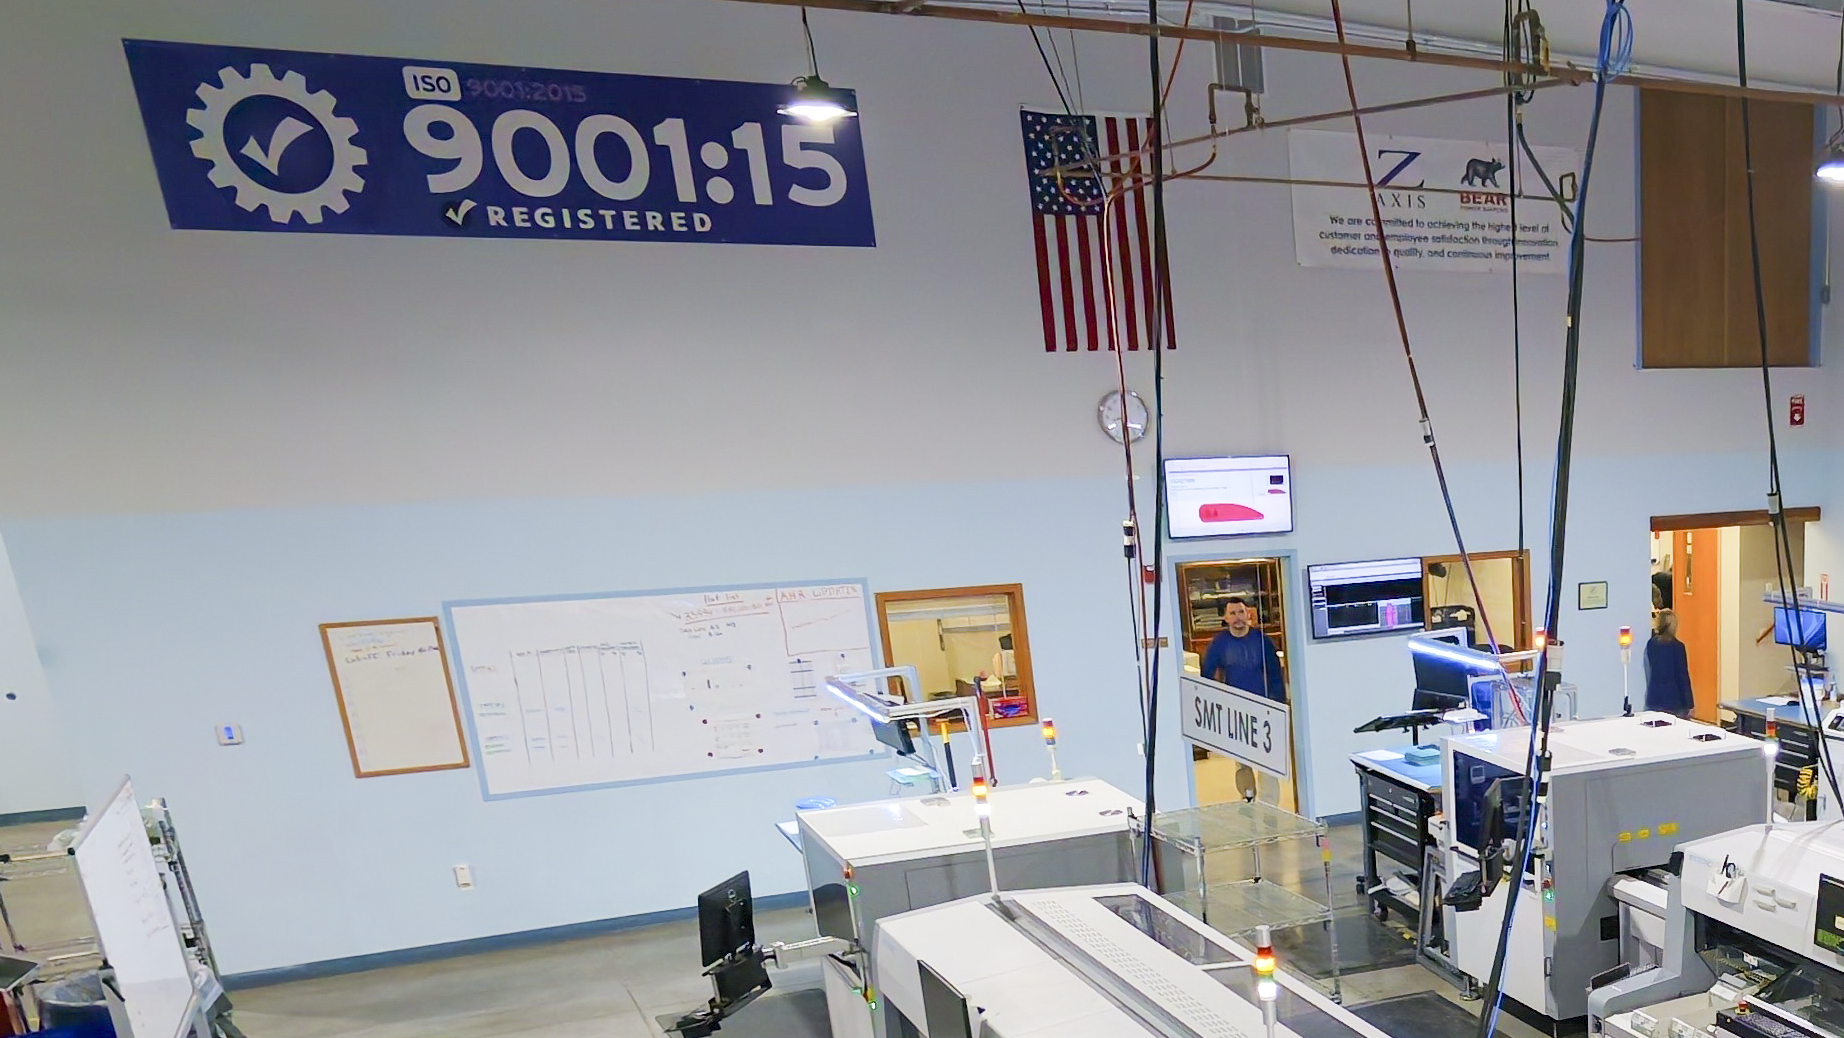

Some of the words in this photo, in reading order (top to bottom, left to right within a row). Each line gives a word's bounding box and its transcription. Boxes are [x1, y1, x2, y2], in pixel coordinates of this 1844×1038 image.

[413, 74, 451, 93] ISO
[403, 103, 847, 206] 9001:15
[487, 206, 712, 232] REGISTERED
[1329, 216, 1344, 225] We
[1416, 219, 1425, 228] to
[1427, 221, 1469, 232] achieving
[1471, 222, 1486, 231] the
[1319, 231, 1360, 240] customer
[1432, 233, 1479, 245] satisfaction
[1330, 245, 1379, 256] dedication
[1428, 249, 1445, 258] and
[1195, 696, 1222, 735] SMT
[1227, 707, 1258, 748] LINE
[1263, 720, 1272, 753] 3
